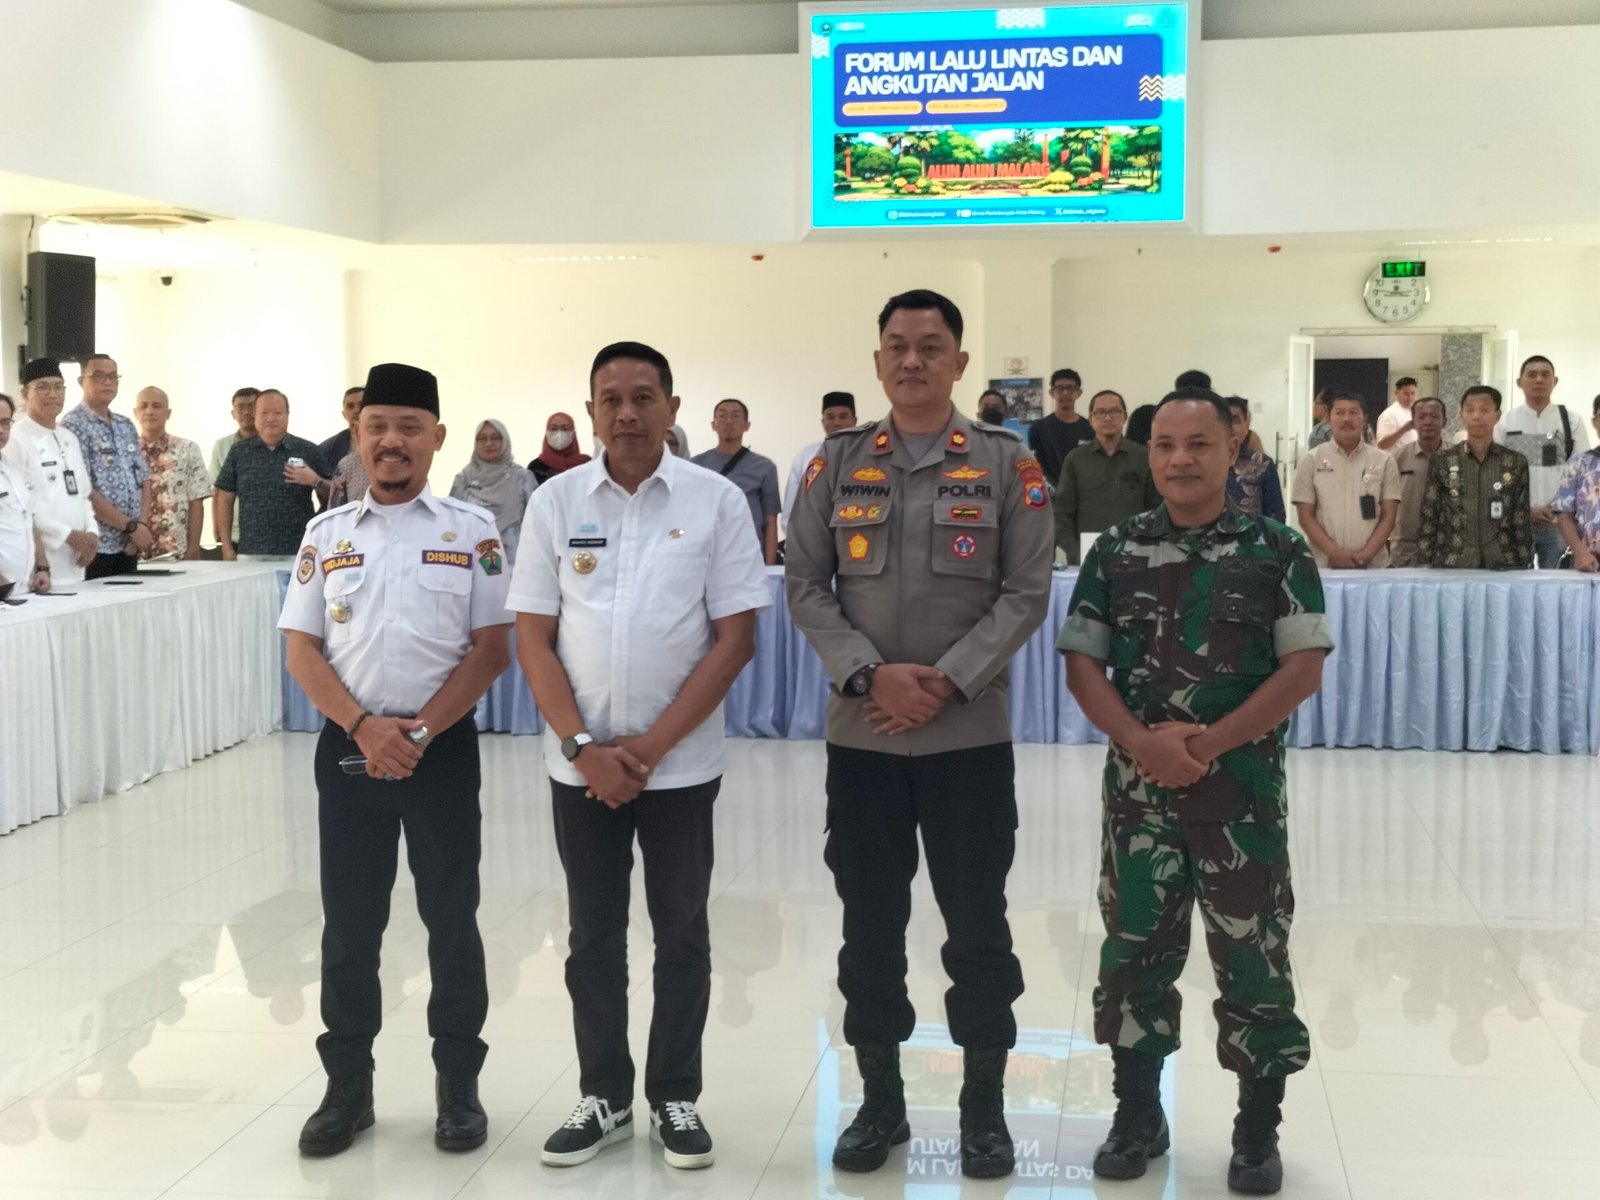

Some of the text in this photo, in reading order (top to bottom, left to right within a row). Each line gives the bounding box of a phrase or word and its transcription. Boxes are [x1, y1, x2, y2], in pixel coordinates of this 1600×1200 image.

[845, 45, 1123, 73] FORUM LALU LINTAS DAN
[844, 70, 1044, 96] ANGKUTAN JALAN
[927, 162, 1051, 179] ALUN ALUN MALANG
[1386, 263, 1420, 276] EXIT
[840, 484, 891, 498] WIWIN
[938, 484, 991, 498] POLRI
[426, 552, 468, 565] DISHUB
